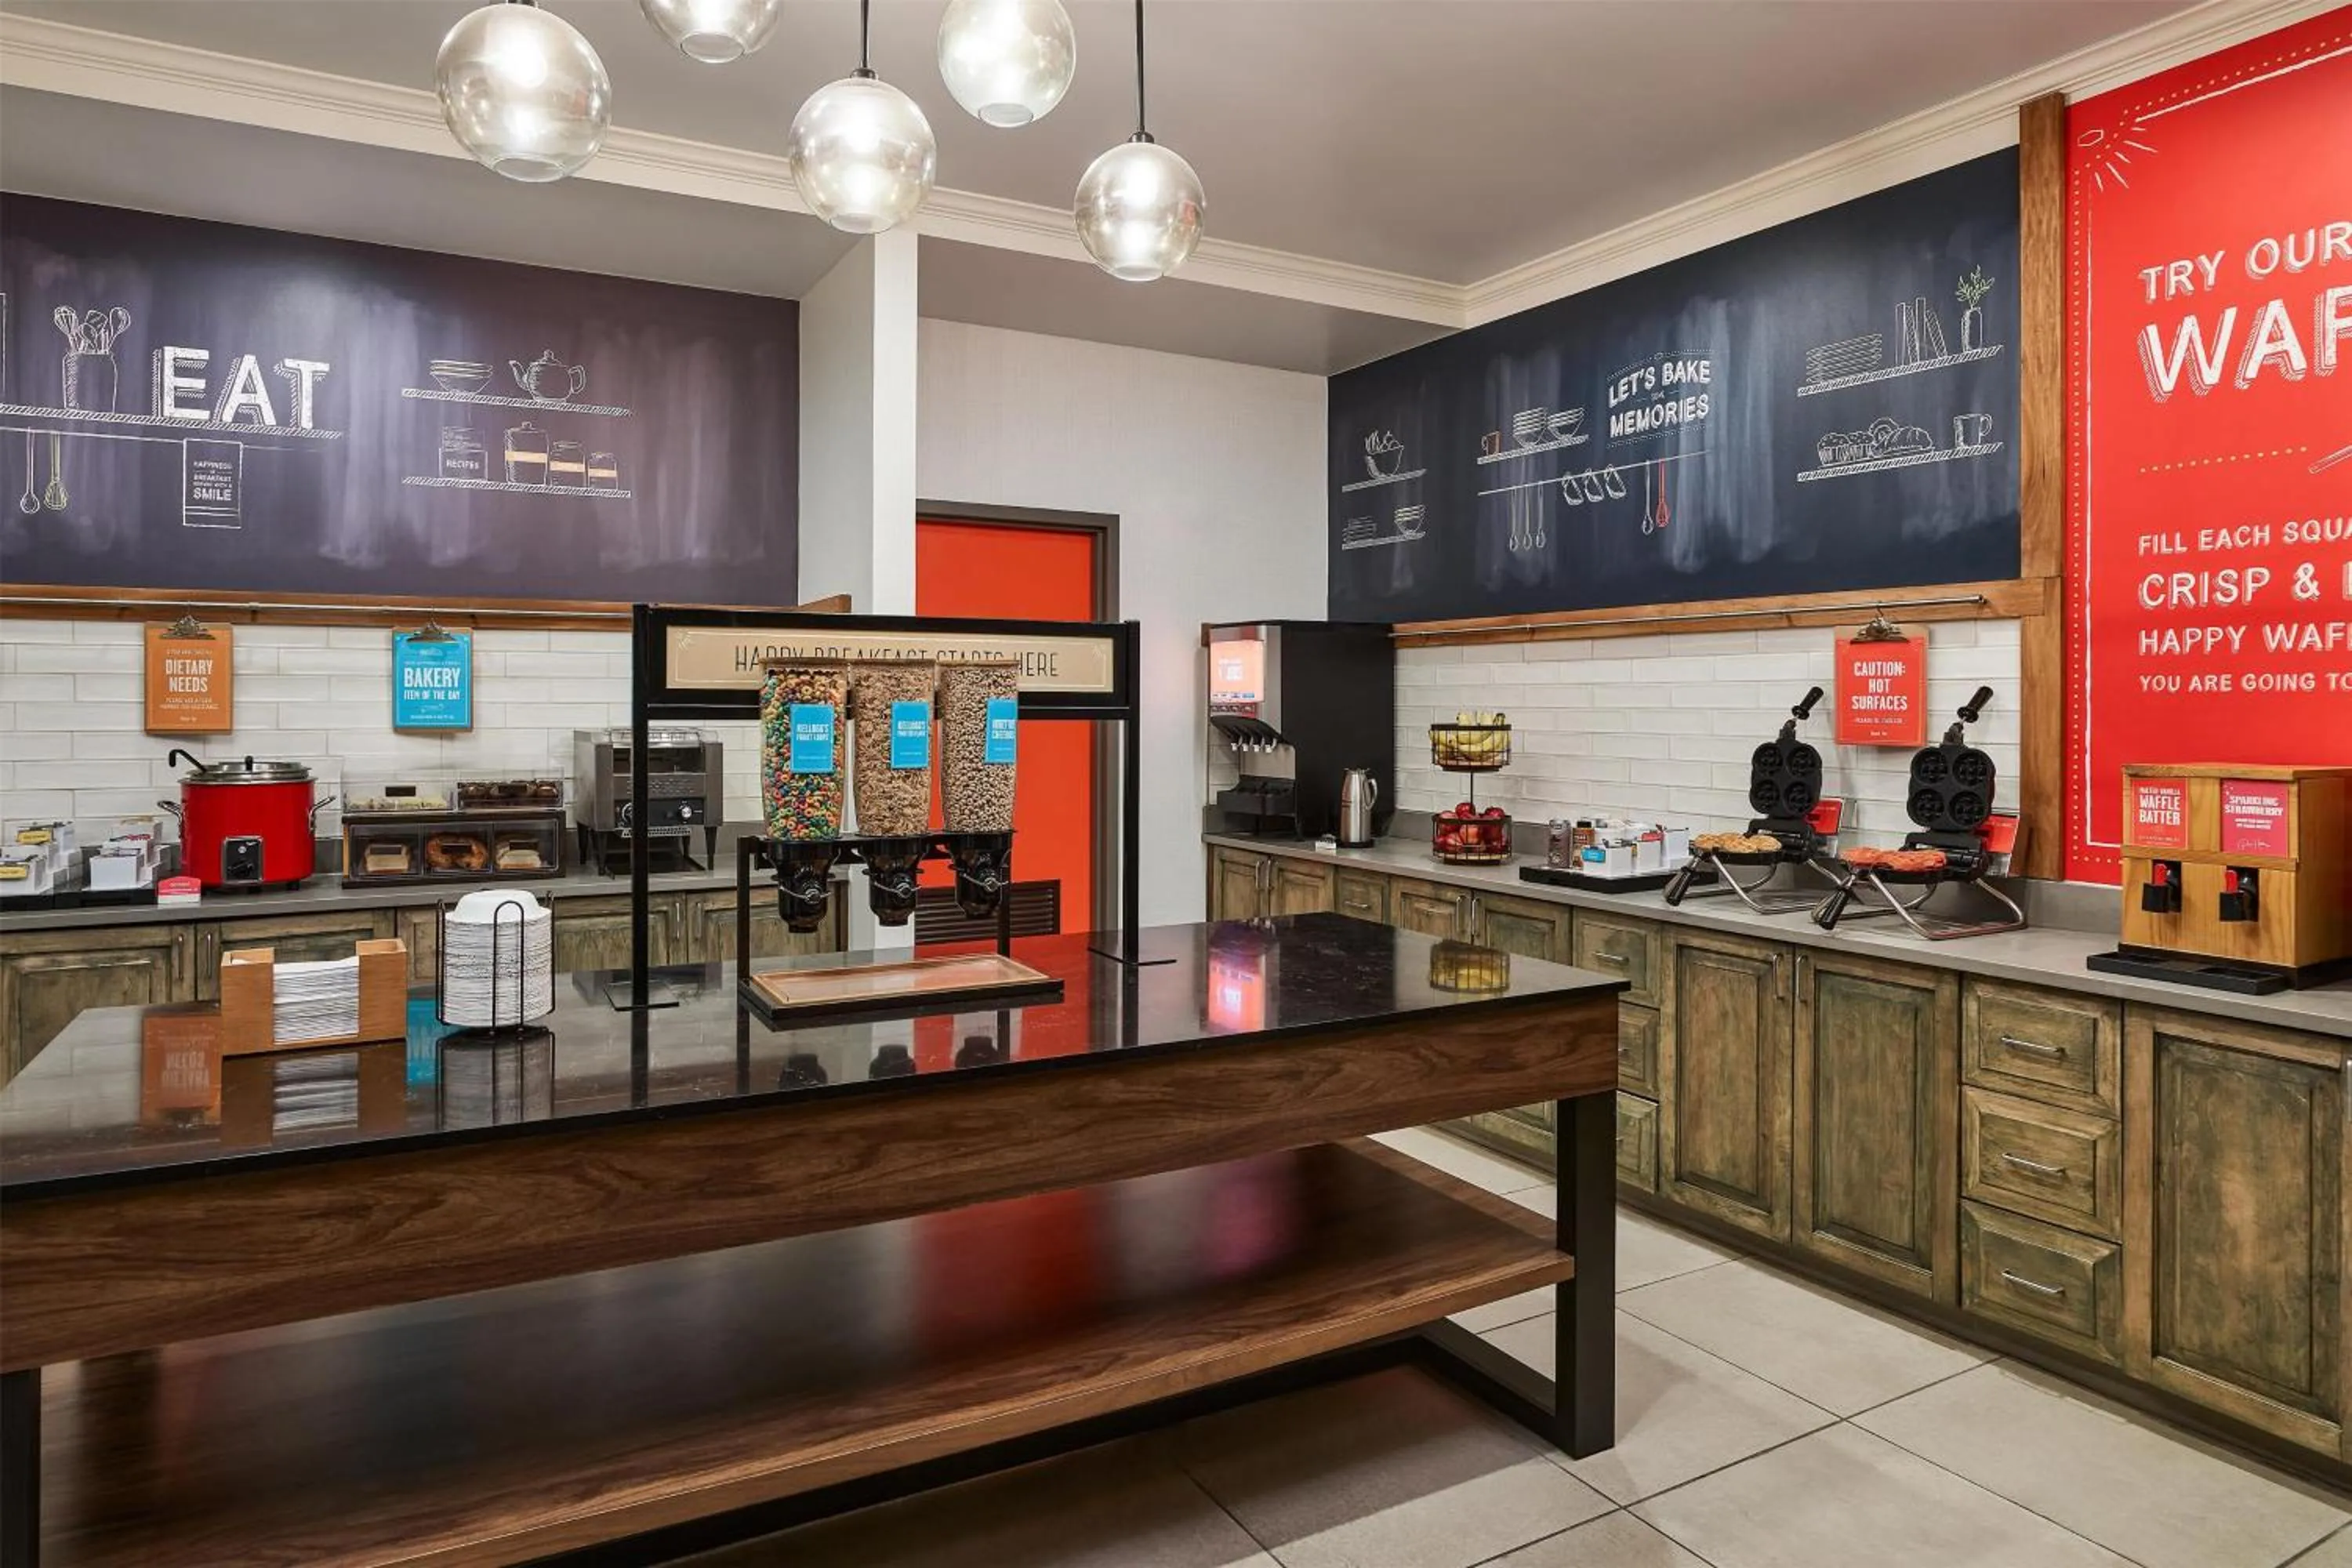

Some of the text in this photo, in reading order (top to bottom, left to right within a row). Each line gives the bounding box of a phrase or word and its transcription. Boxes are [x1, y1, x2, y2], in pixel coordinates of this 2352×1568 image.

[2139, 221, 2352, 303] TRY OUR
[151, 346, 330, 430] EAT
[1609, 360, 1711, 408] LET'S BAKE
[1610, 394, 1709, 438] MEMORIES
[193, 487, 232, 501] SMILE
[2138, 532, 2188, 556] FILL
[2198, 524, 2270, 551] EACH
[2138, 566, 2270, 609] CRISP
[2292, 562, 2321, 601] &
[2138, 622, 2352, 655] HAPPY WAF
[165, 659, 213, 675] DIETARY
[1853, 661, 1906, 677] CAUTION:
[169, 677, 208, 692] NEEDS
[404, 667, 461, 688] BAKERY
[1868, 678, 1892, 694] HOT
[2139, 675, 2180, 692] YOU
[2188, 674, 2233, 692] ARE
[2241, 673, 2316, 691] GOING
[433, 690, 445, 700] THE
[1851, 695, 1907, 710] SURFACES
[2140, 794, 2180, 810] WAFFLE
[2225, 805, 2284, 816] STRAWBERRY
[2140, 809, 2180, 826] BATTER
